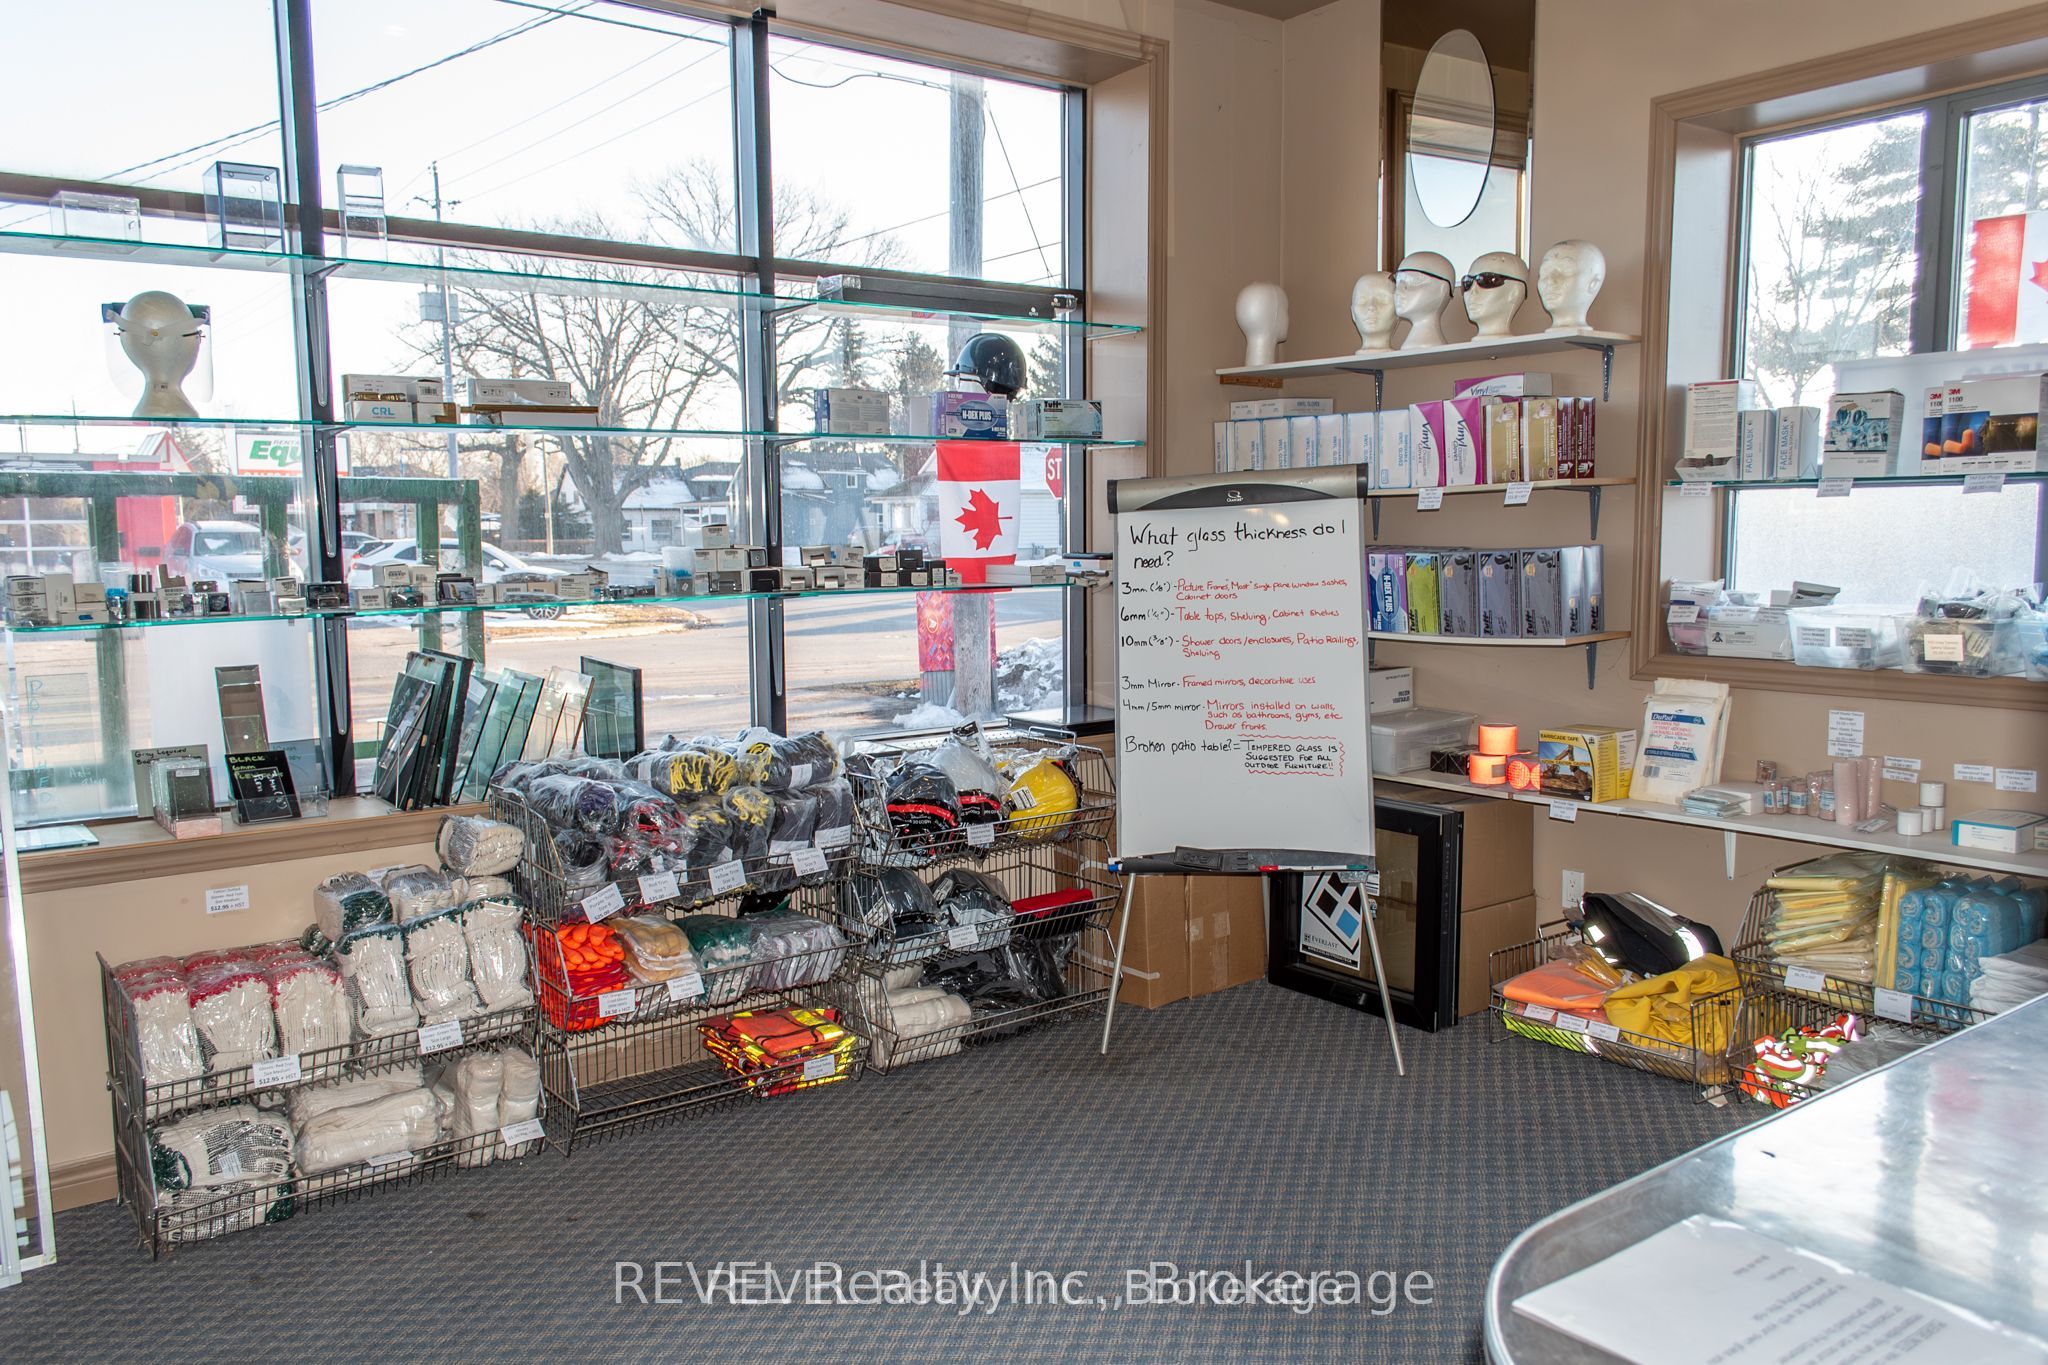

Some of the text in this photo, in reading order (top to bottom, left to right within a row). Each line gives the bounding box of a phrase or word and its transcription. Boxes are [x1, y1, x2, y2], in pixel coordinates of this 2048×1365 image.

[1470, 387, 1489, 396] Vinyl
[371, 406, 395, 417] CRL
[962, 409, 992, 421] N-DEX PLUS
[1422, 423, 1432, 450] Vinyl
[1457, 419, 1468, 448] Vinyl
[1781, 424, 1789, 447] MASK
[249, 440, 301, 467] Equ
[1745, 428, 1754, 473] FACE MASK
[1047, 458, 1062, 481] ST
[1130, 523, 1178, 545] What
[1187, 527, 1225, 552] glass
[1234, 521, 1306, 540] thickness
[1312, 522, 1335, 536] do
[1133, 551, 1174, 569] need?
[1121, 582, 1147, 595] 3mm
[1384, 574, 1394, 612] N-DEX PLUS
[1176, 591, 1238, 601] Cabinet doors
[1120, 606, 1146, 622] 6mm
[1272, 609, 1304, 619] Cabinet
[1121, 636, 1147, 647] 10mm
[1181, 635, 1213, 648] Shower
[1296, 634, 1323, 645] Patio
[1121, 676, 1144, 690] 3mm
[1182, 676, 1213, 688] Framed
[1248, 676, 1295, 685] decorative
[1299, 676, 1316, 684] uses
[1207, 700, 1245, 711] Mirrors
[1251, 700, 1291, 710] installed
[1207, 711, 1229, 719] such
[1246, 711, 1291, 720] bathrooms,
[1205, 720, 1236, 730] Drawer
[1125, 735, 1166, 753] Broken
[1171, 739, 1197, 755] patio
[1240, 740, 1291, 753] TEMPERED
[1295, 744, 1323, 753] GLASS
[229, 755, 265, 764] BLACK
[1245, 753, 1295, 762] SUGGESTED
[1299, 754, 1314, 762] FOR
[1244, 761, 1279, 769] OUTDOOR
[1311, 936, 1338, 948] EVERLAST
[425, 1043, 444, 1052] $12.95
[259, 1076, 280, 1085] $12.95
